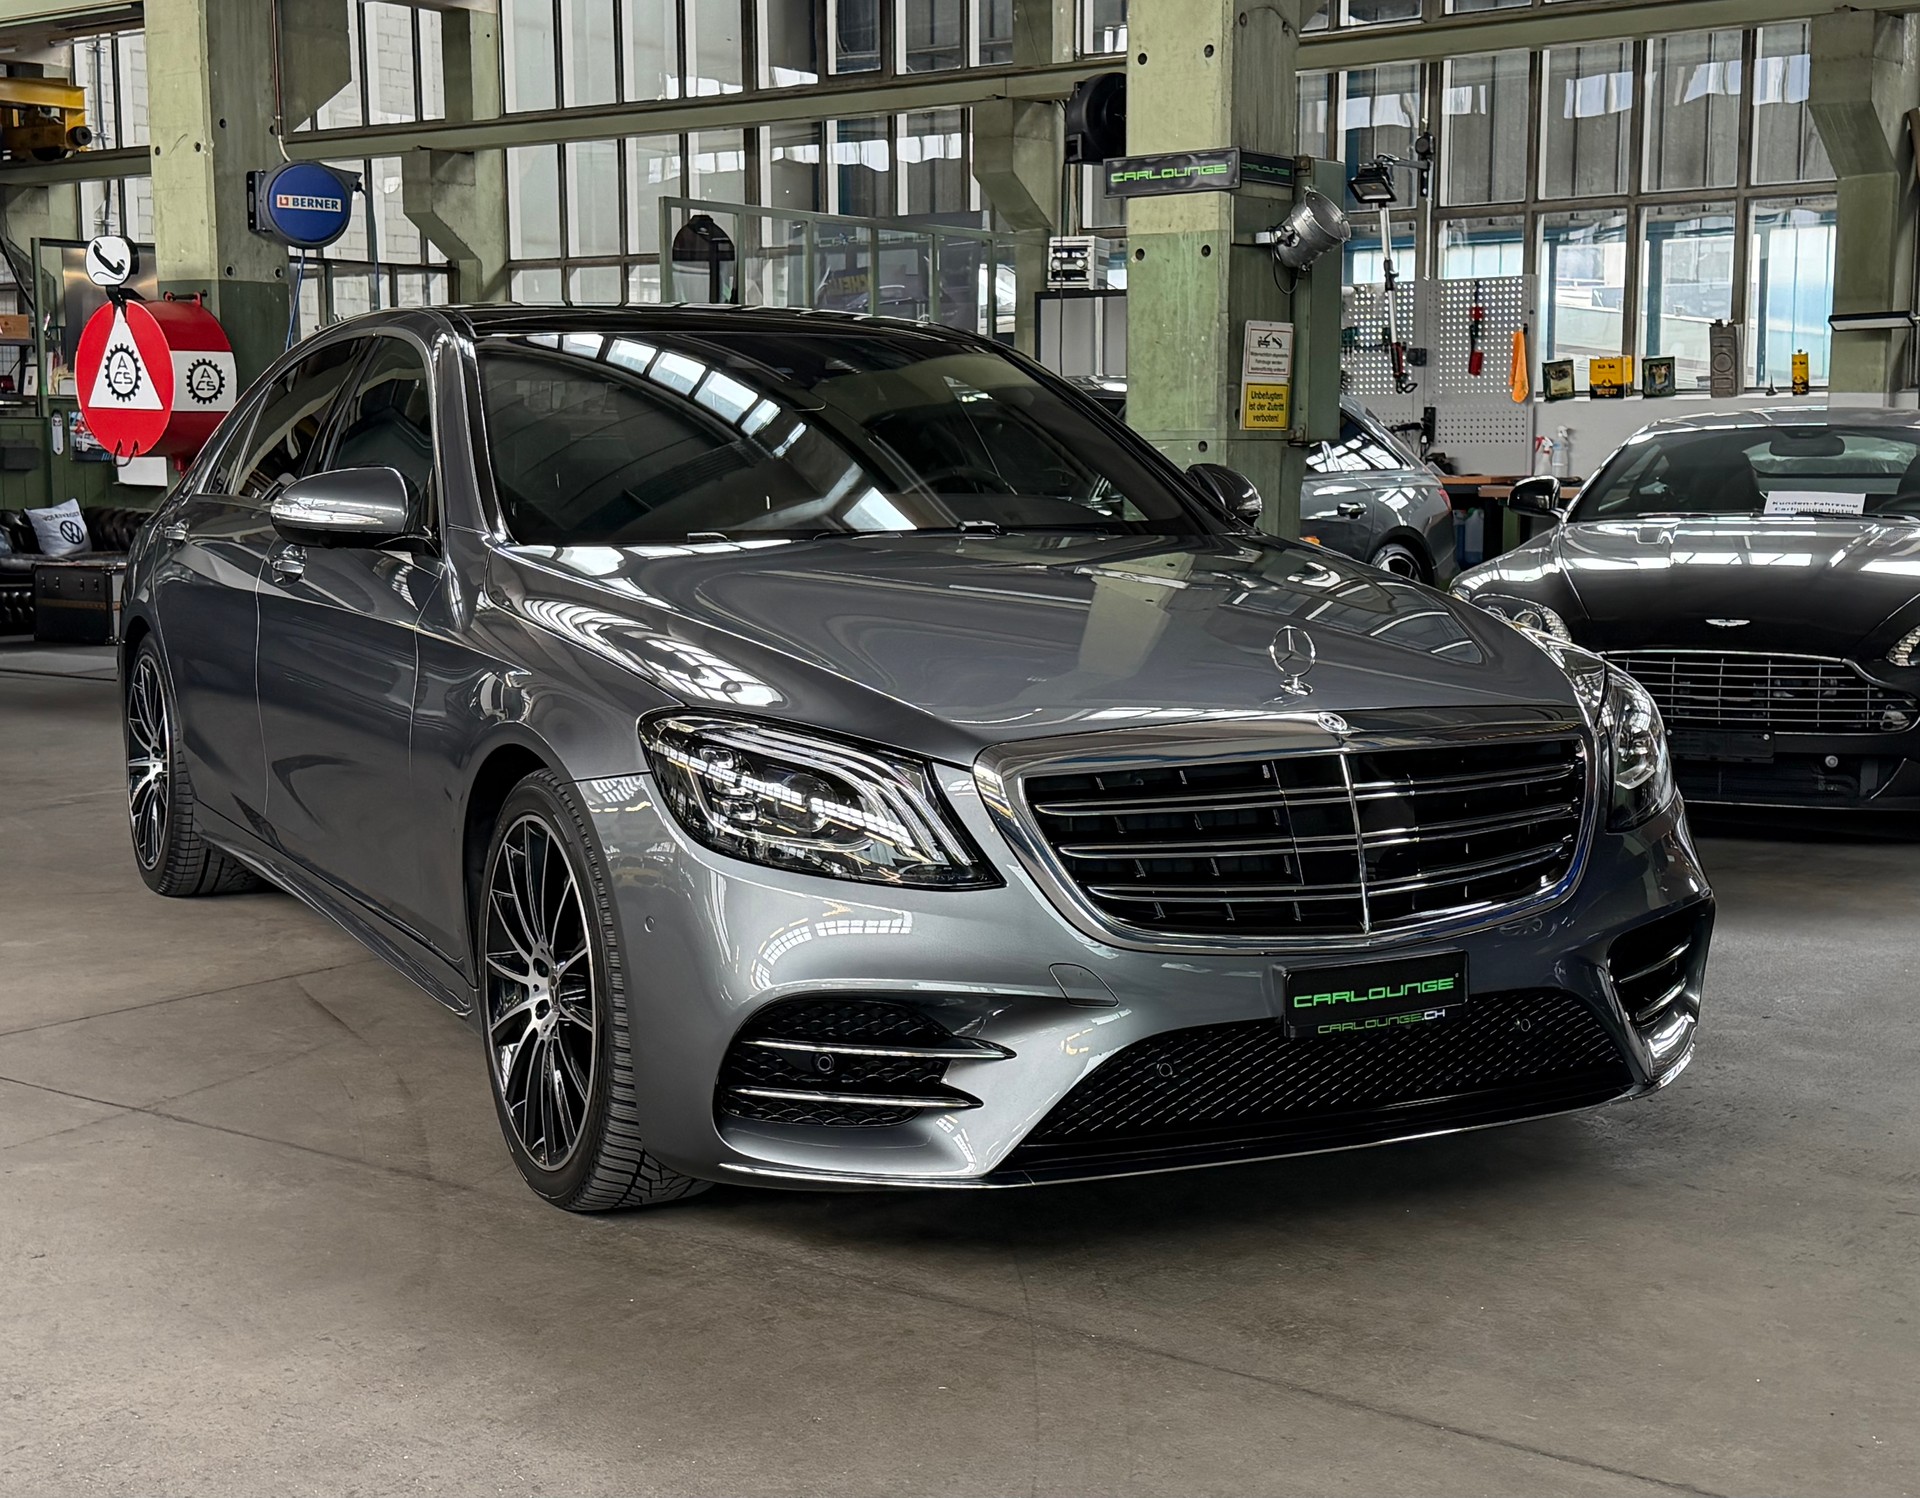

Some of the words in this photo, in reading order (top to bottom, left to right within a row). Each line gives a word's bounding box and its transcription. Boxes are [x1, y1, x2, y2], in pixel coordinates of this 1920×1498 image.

[1110, 163, 1228, 183] CARLOUNGE
[292, 197, 339, 210] BERNER
[1250, 390, 1284, 402] Unbefugten
[1248, 402, 1256, 411] ist
[1257, 402, 1266, 411] der
[1267, 402, 1285, 411] Zutritt
[1252, 414, 1280, 423] verboten!
[1293, 977, 1455, 1008] CARLOUNGE
[1317, 1008, 1446, 1034] CARLOUNGE.CH
